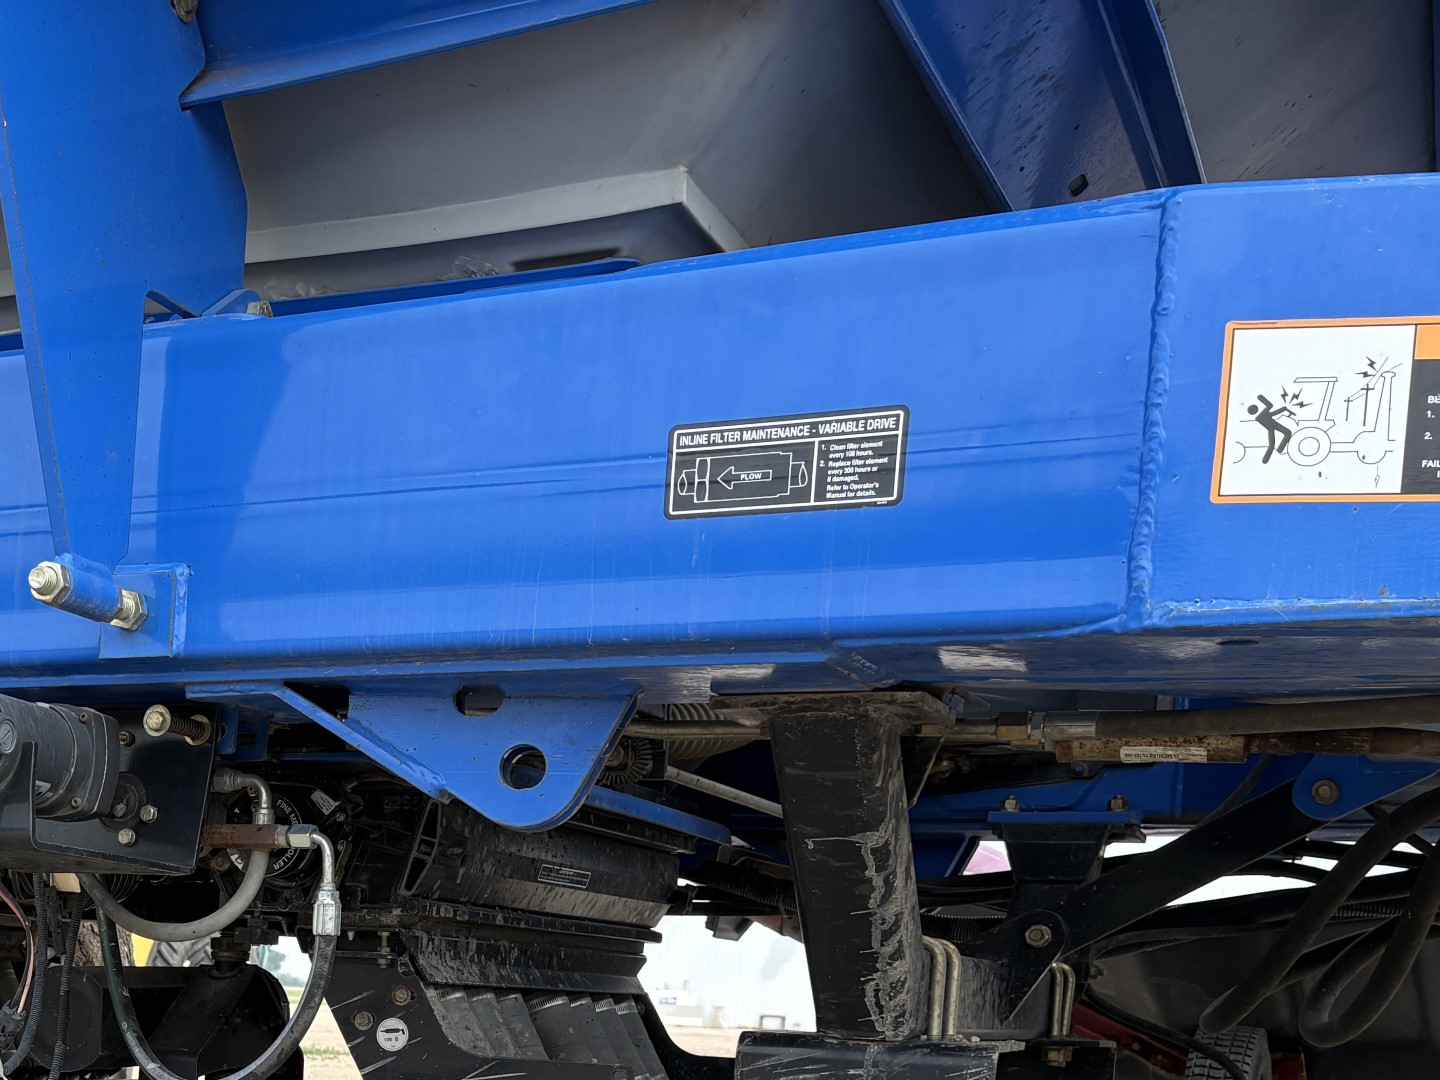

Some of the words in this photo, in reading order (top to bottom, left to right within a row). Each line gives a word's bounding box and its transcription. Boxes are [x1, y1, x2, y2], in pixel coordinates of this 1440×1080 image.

[1426, 409, 1435, 418] 1.
[679, 433, 708, 447] INLINE
[710, 431, 741, 444] FILTER
[742, 425, 811, 442] MAINTENANCE
[818, 420, 865, 435] VARIABLE
[866, 417, 897, 430] DRIVE
[1424, 431, 1433, 440] 2.
[830, 443, 846, 451] Clean
[860, 441, 883, 449] element
[828, 460, 851, 468] Replace
[276, 800, 293, 815] FINE
[273, 848, 296, 870] OLLER
